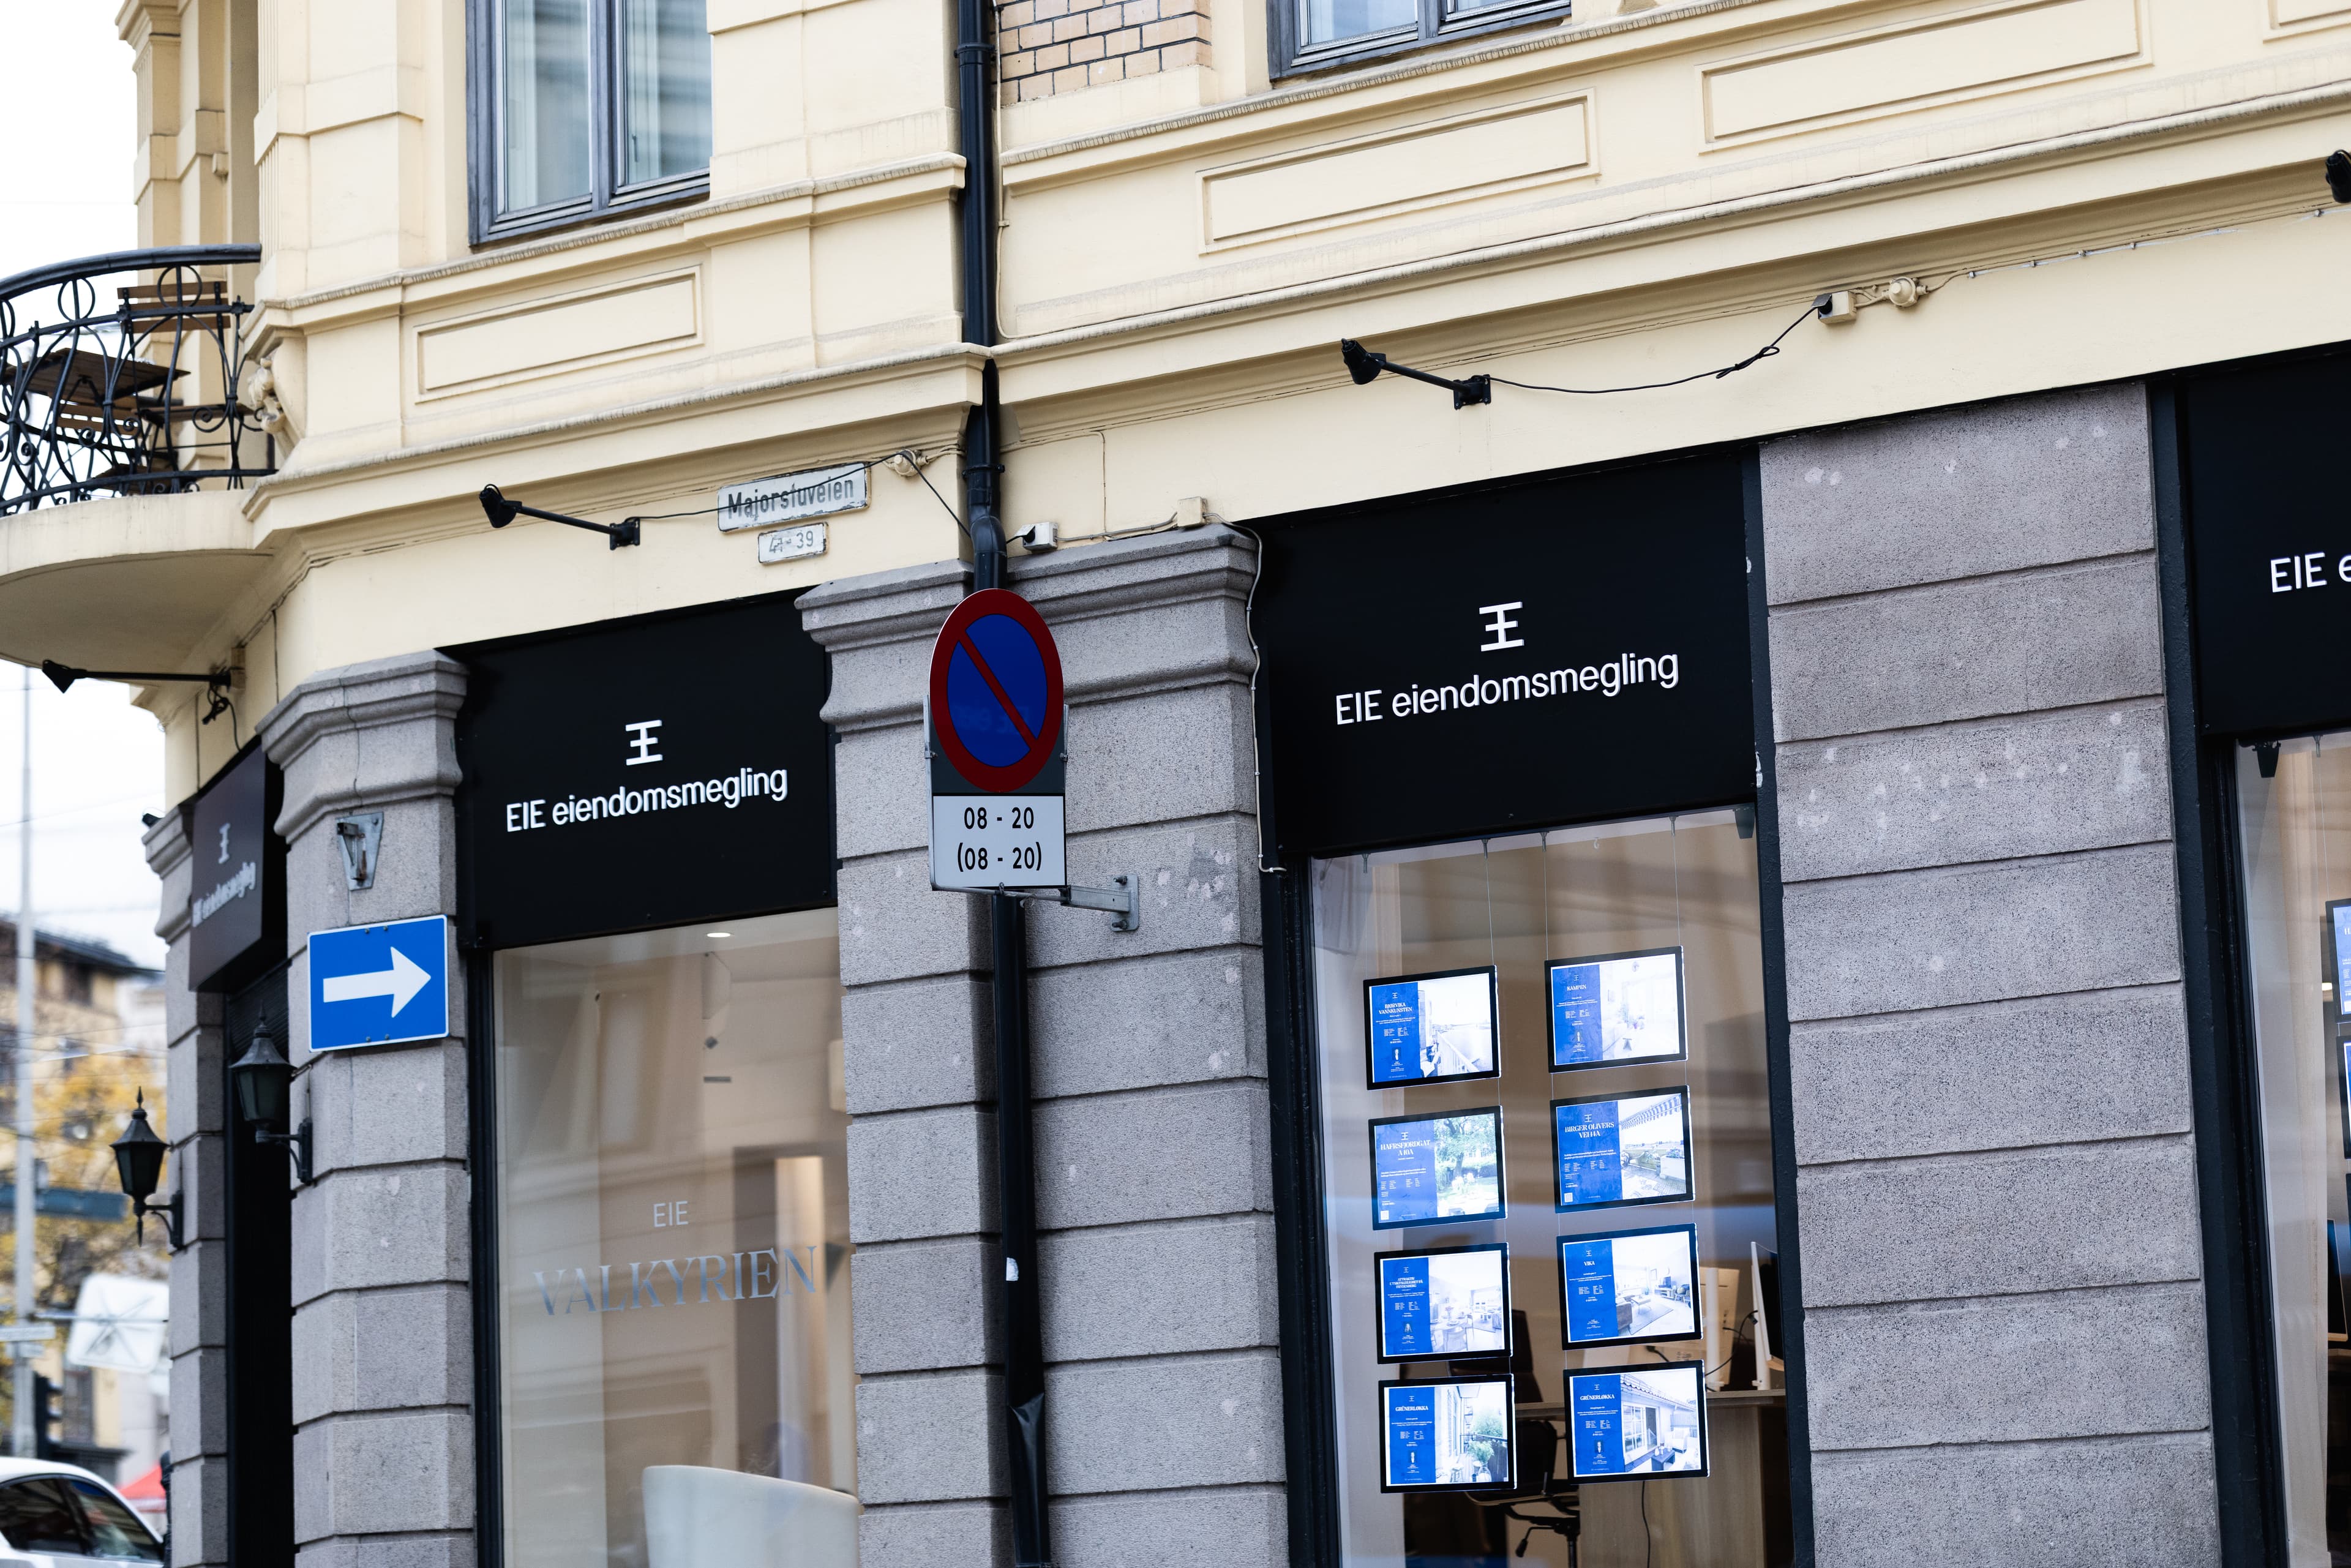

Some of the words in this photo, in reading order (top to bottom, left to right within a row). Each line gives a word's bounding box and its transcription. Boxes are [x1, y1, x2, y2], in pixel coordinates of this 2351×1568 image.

[728, 476, 854, 520] Majorstuveien
[2270, 552, 2327, 593] EIE
[1336, 689, 1383, 725] EIE
[1392, 653, 1679, 718] eiendomsmegling
[507, 799, 546, 832] EIE
[552, 768, 788, 825] eiendomsmegling
[964, 807, 988, 829] 08
[1011, 807, 1034, 829] 20
[958, 842, 988, 872] (08
[1012, 842, 1041, 871] 20)
[1564, 1124, 1588, 1133] BIRGER
[1588, 1122, 1614, 1130] OLIVERS
[653, 1201, 689, 1227] EIE
[532, 1246, 817, 1316] VALKYRIEN
